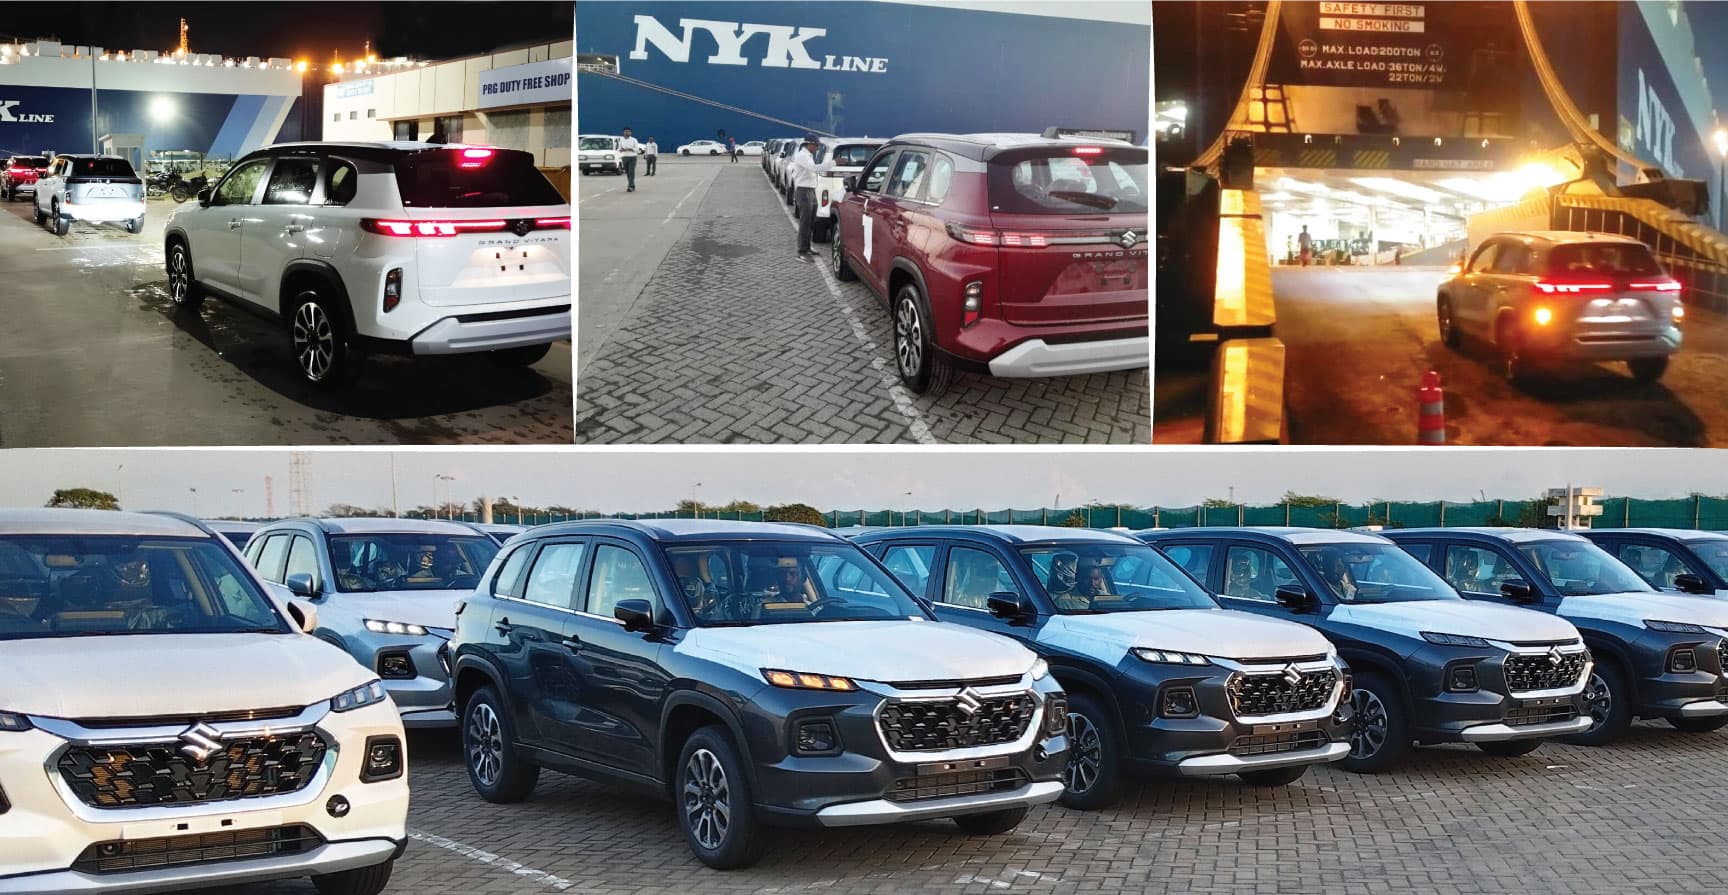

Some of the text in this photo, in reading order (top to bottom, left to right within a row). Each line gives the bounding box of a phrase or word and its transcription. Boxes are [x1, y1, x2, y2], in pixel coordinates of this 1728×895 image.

[1324, 3, 1420, 16] SAFETY FIRST
[1334, 19, 1411, 31] NO SMOKING
[629, 14, 889, 73] NYK LINE
[482, 72, 571, 95] PRG DUTY FREE SHOP
[19, 114, 55, 122] LINE
[1637, 67, 1676, 177] NYK
